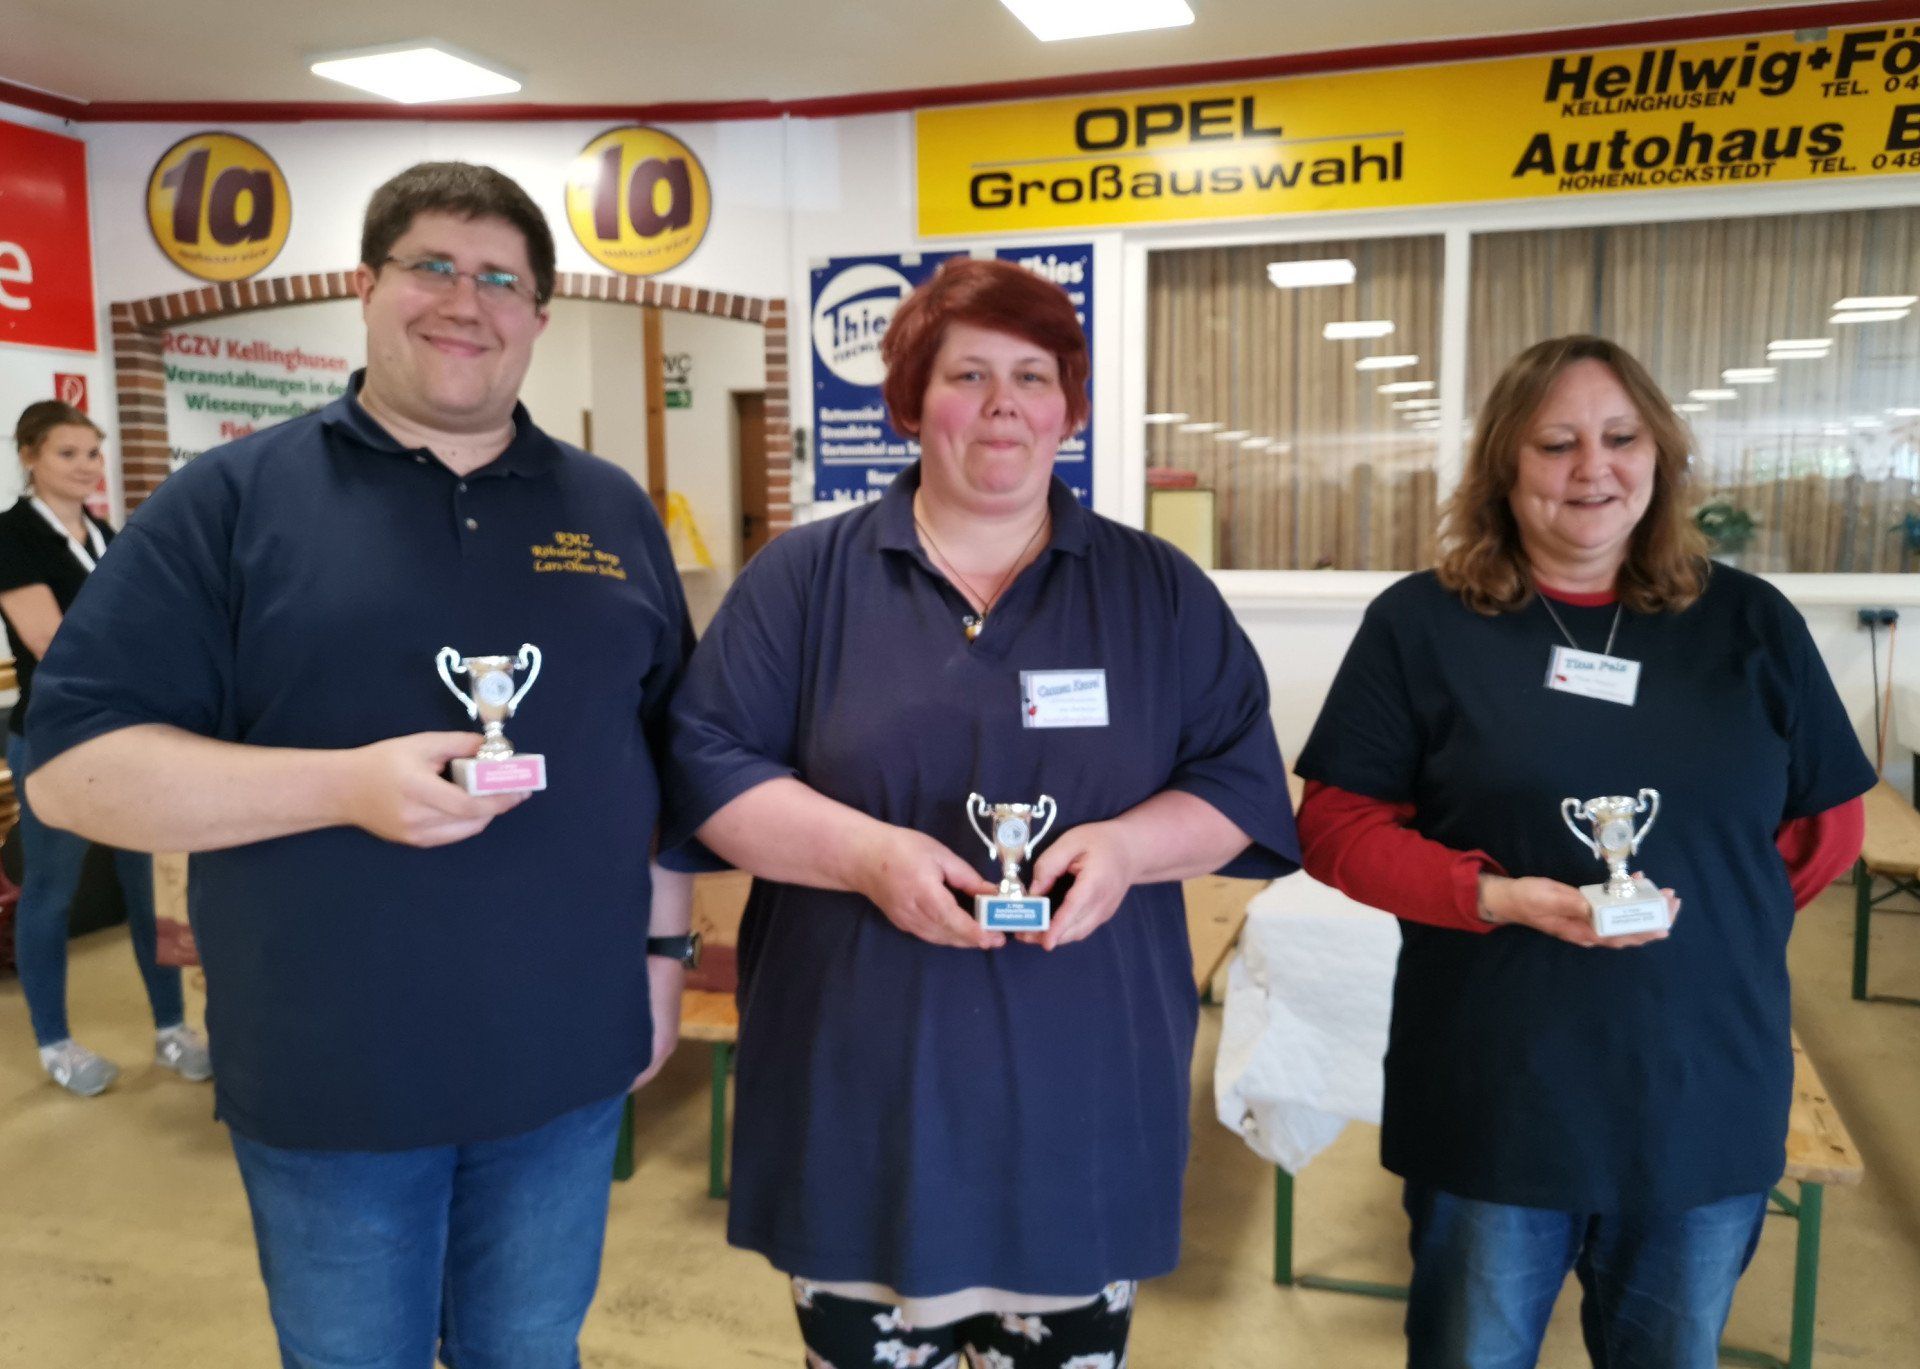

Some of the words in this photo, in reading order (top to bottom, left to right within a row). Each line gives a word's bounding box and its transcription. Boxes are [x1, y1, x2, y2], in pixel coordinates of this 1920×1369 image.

[1074, 96, 1283, 152] OPEL
[1561, 91, 1736, 118] KELLINGHUSEN
[1820, 80, 1869, 98] TEL.
[969, 141, 1404, 209] Großauswahl
[1511, 121, 1845, 178] Autohaus
[1558, 162, 1776, 191] HOHENLOCKSTEDT
[1809, 157, 1857, 174] TEL.
[161, 147, 275, 247] 1a
[579, 143, 692, 240] 1a
[823, 285, 900, 346] Thie
[164, 364, 306, 395] Veranstaltungen
[226, 340, 348, 372] Kellinghusen
